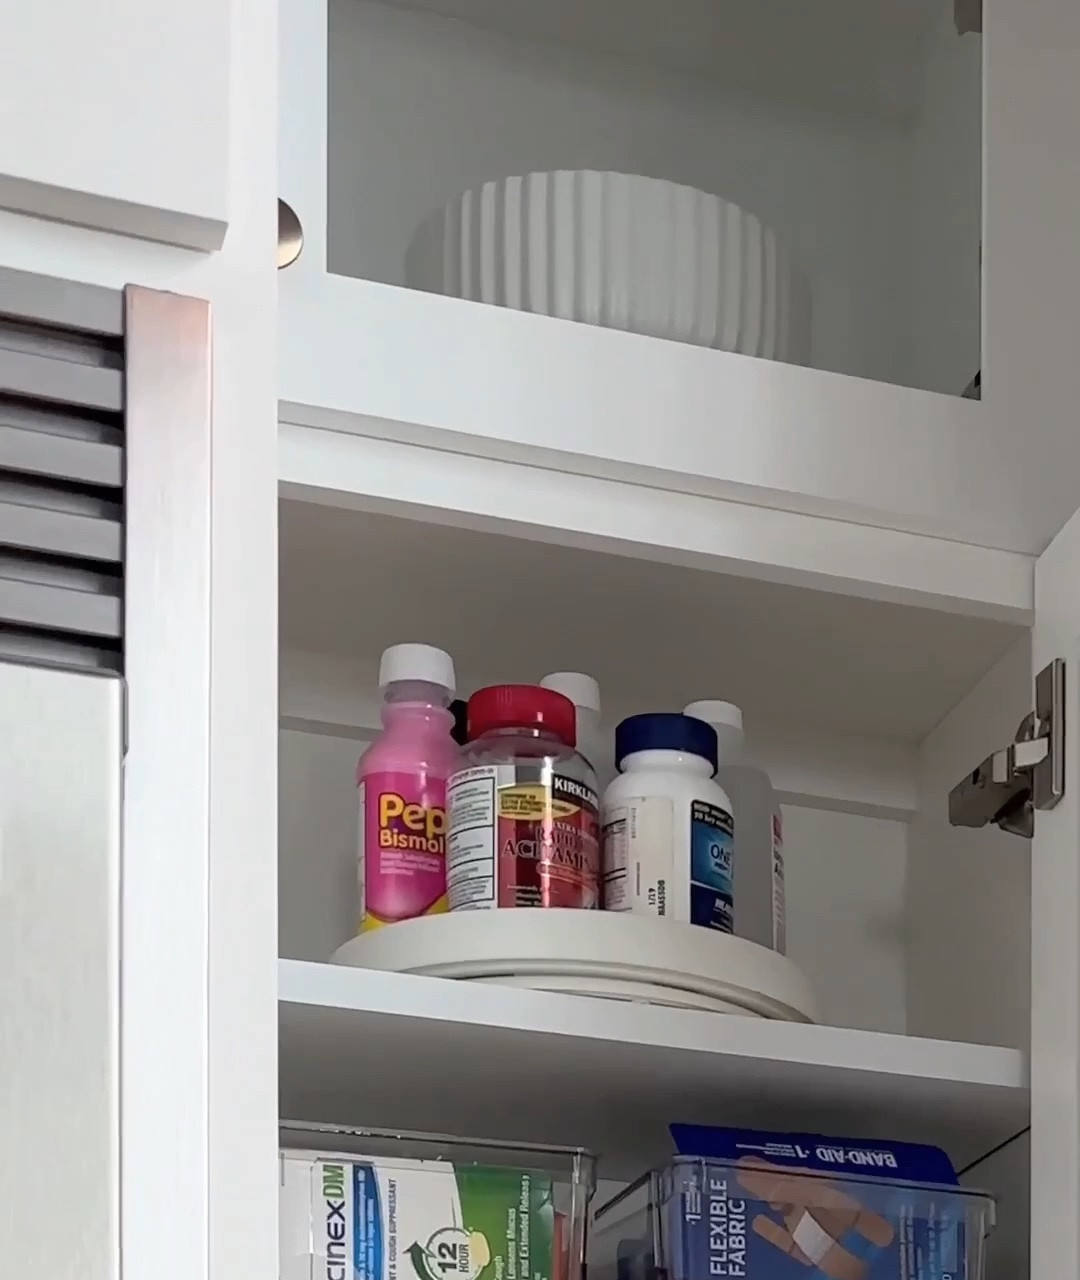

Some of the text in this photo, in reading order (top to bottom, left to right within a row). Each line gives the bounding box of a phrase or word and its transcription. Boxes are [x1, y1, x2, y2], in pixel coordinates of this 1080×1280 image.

[380, 828, 444, 854] Bismol
[816, 1145, 898, 1168] BAND-AID
[322, 1163, 346, 1199] DM
[387, 1178, 397, 1234] SUPPRESSANT
[506, 1207, 516, 1239] Mucus
[519, 1213, 529, 1258] Extended
[710, 1179, 728, 1275] FLEXIBLE
[728, 1199, 747, 1277] FABRIC
[388, 1235, 398, 1262] COUGH
[437, 1242, 458, 1274] 12
[458, 1243, 470, 1273] HOUR
